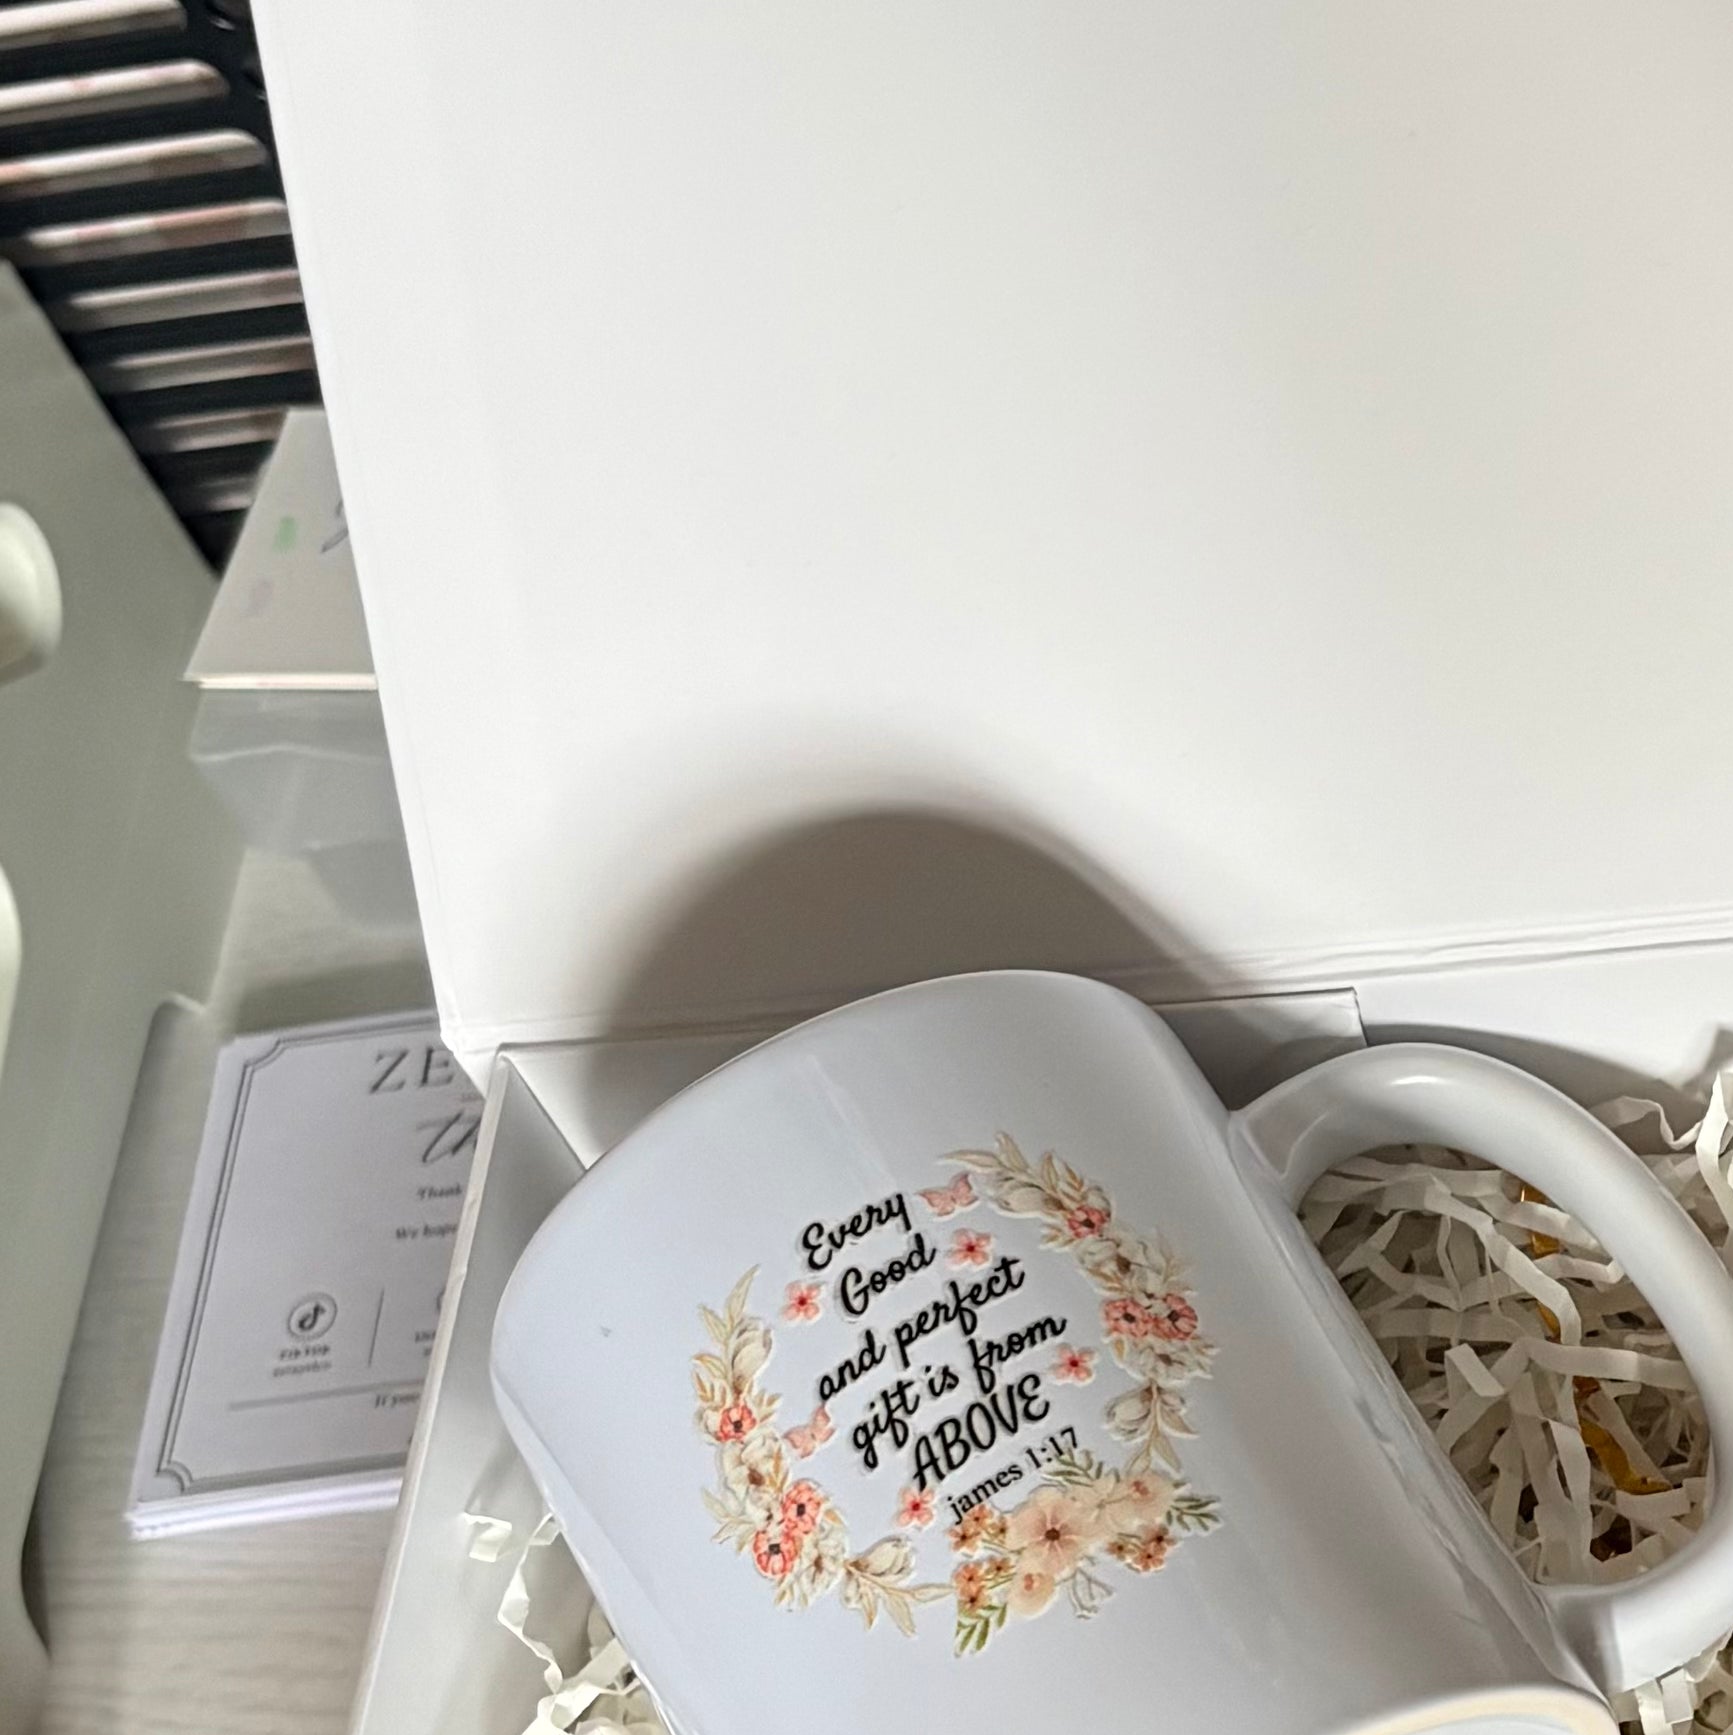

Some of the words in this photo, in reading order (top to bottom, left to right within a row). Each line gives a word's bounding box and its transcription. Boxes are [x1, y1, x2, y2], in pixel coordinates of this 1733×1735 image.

[801, 1193, 912, 1271] Every
[840, 1233, 936, 1316] Good
[819, 1329, 887, 1401] and
[895, 1257, 1025, 1369] perfect
[852, 1380, 920, 1470] gift
[925, 1364, 960, 1398] is
[968, 1317, 1067, 1395] from
[913, 1373, 1050, 1493] ABOVE
[948, 1463, 1023, 1526] james
[1025, 1426, 1079, 1470] 1:17
